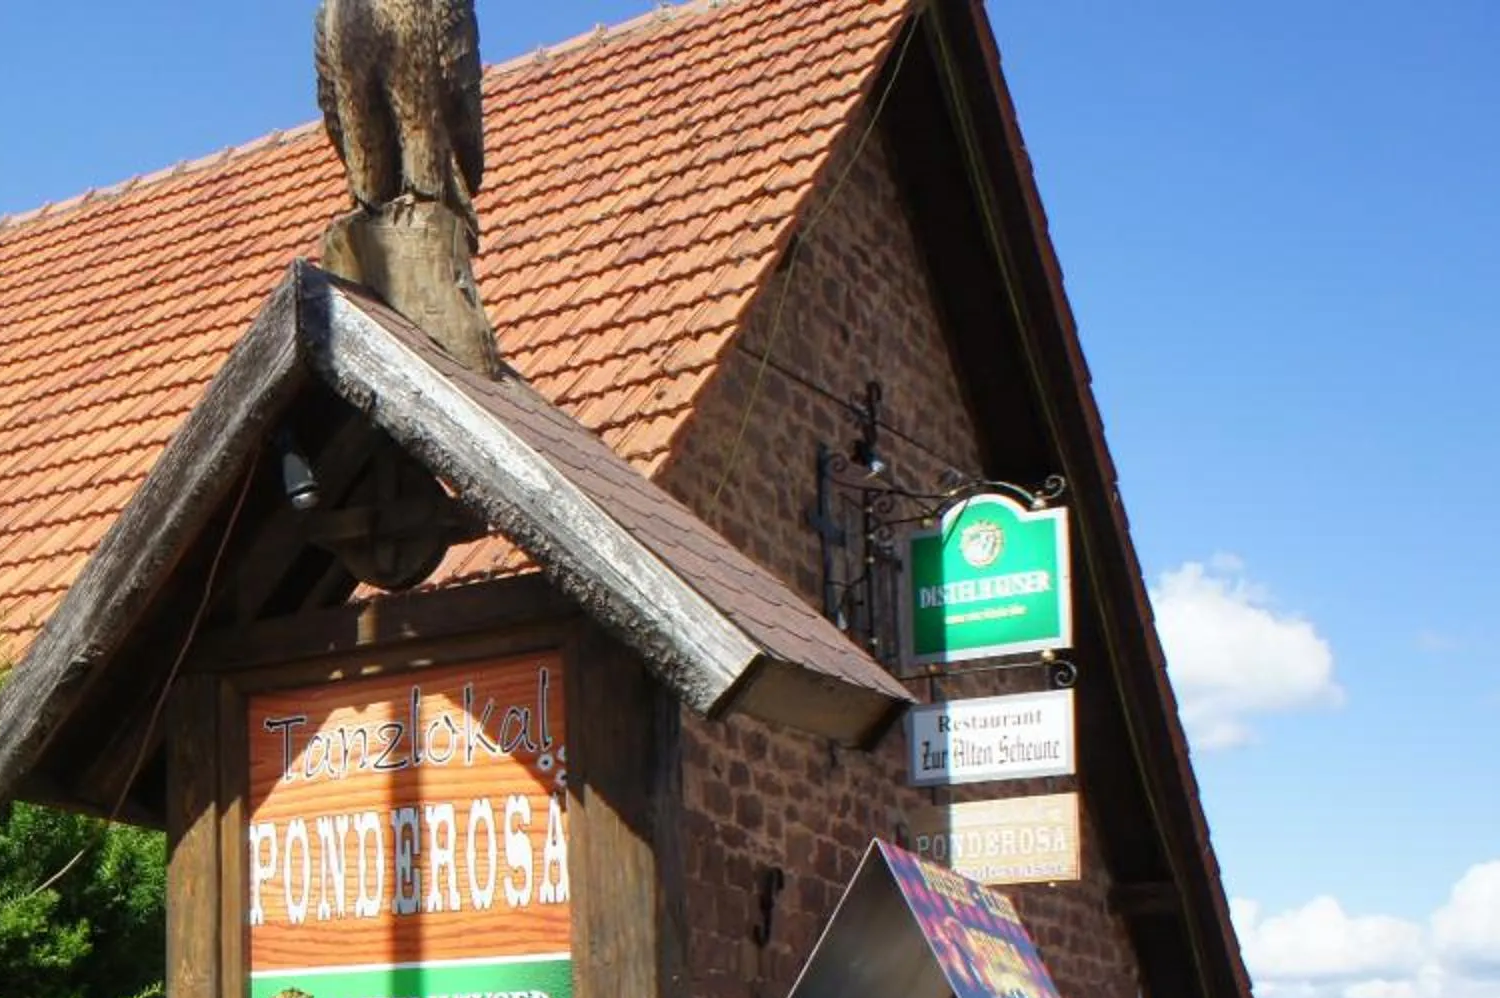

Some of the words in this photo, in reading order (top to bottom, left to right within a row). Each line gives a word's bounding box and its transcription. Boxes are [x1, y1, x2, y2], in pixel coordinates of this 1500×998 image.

[264, 666, 553, 784] Tanzlokal
[921, 740, 949, 771] Zur
[953, 738, 994, 768] Alten
[998, 734, 1061, 765] Scheune
[938, 708, 1042, 733] Restaurant
[249, 793, 570, 926] PONDEROSA
